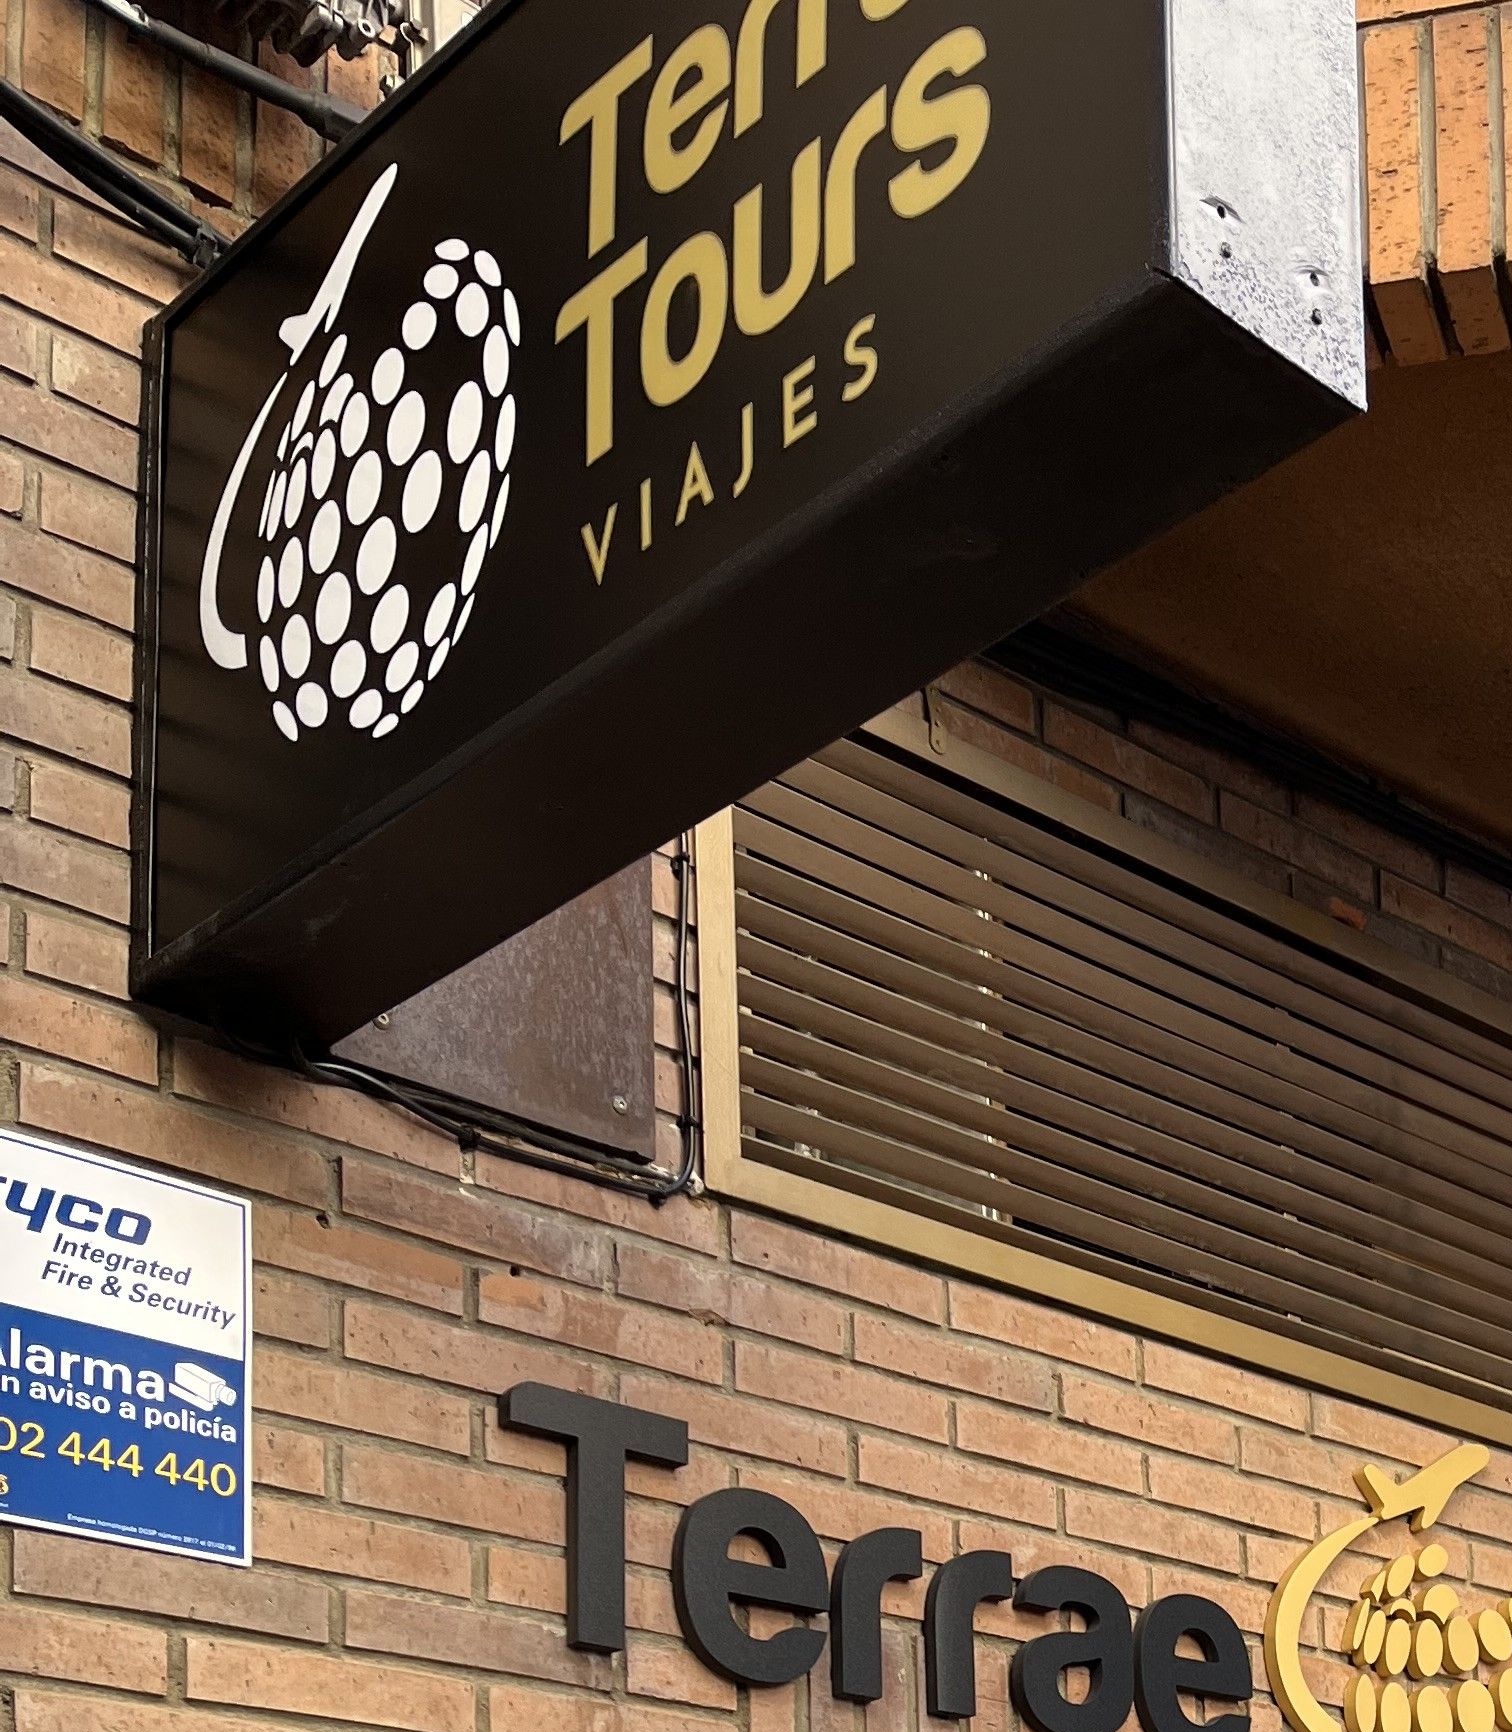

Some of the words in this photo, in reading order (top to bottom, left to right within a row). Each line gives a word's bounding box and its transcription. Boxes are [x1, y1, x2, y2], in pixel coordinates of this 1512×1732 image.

[554, 25, 992, 467] Tours
[581, 313, 878, 586] VIAJES
[0, 1176, 152, 1246] yco
[52, 1232, 193, 1286] Integrated
[41, 1259, 94, 1290] Fire
[100, 1275, 123, 1298] &
[128, 1283, 236, 1330] Security
[0, 1327, 165, 1402] larma
[28, 1381, 112, 1414] aviso
[118, 1401, 136, 1421] a
[144, 1407, 237, 1443] policía
[57, 1431, 144, 1478] 444
[154, 1452, 237, 1498] 440
